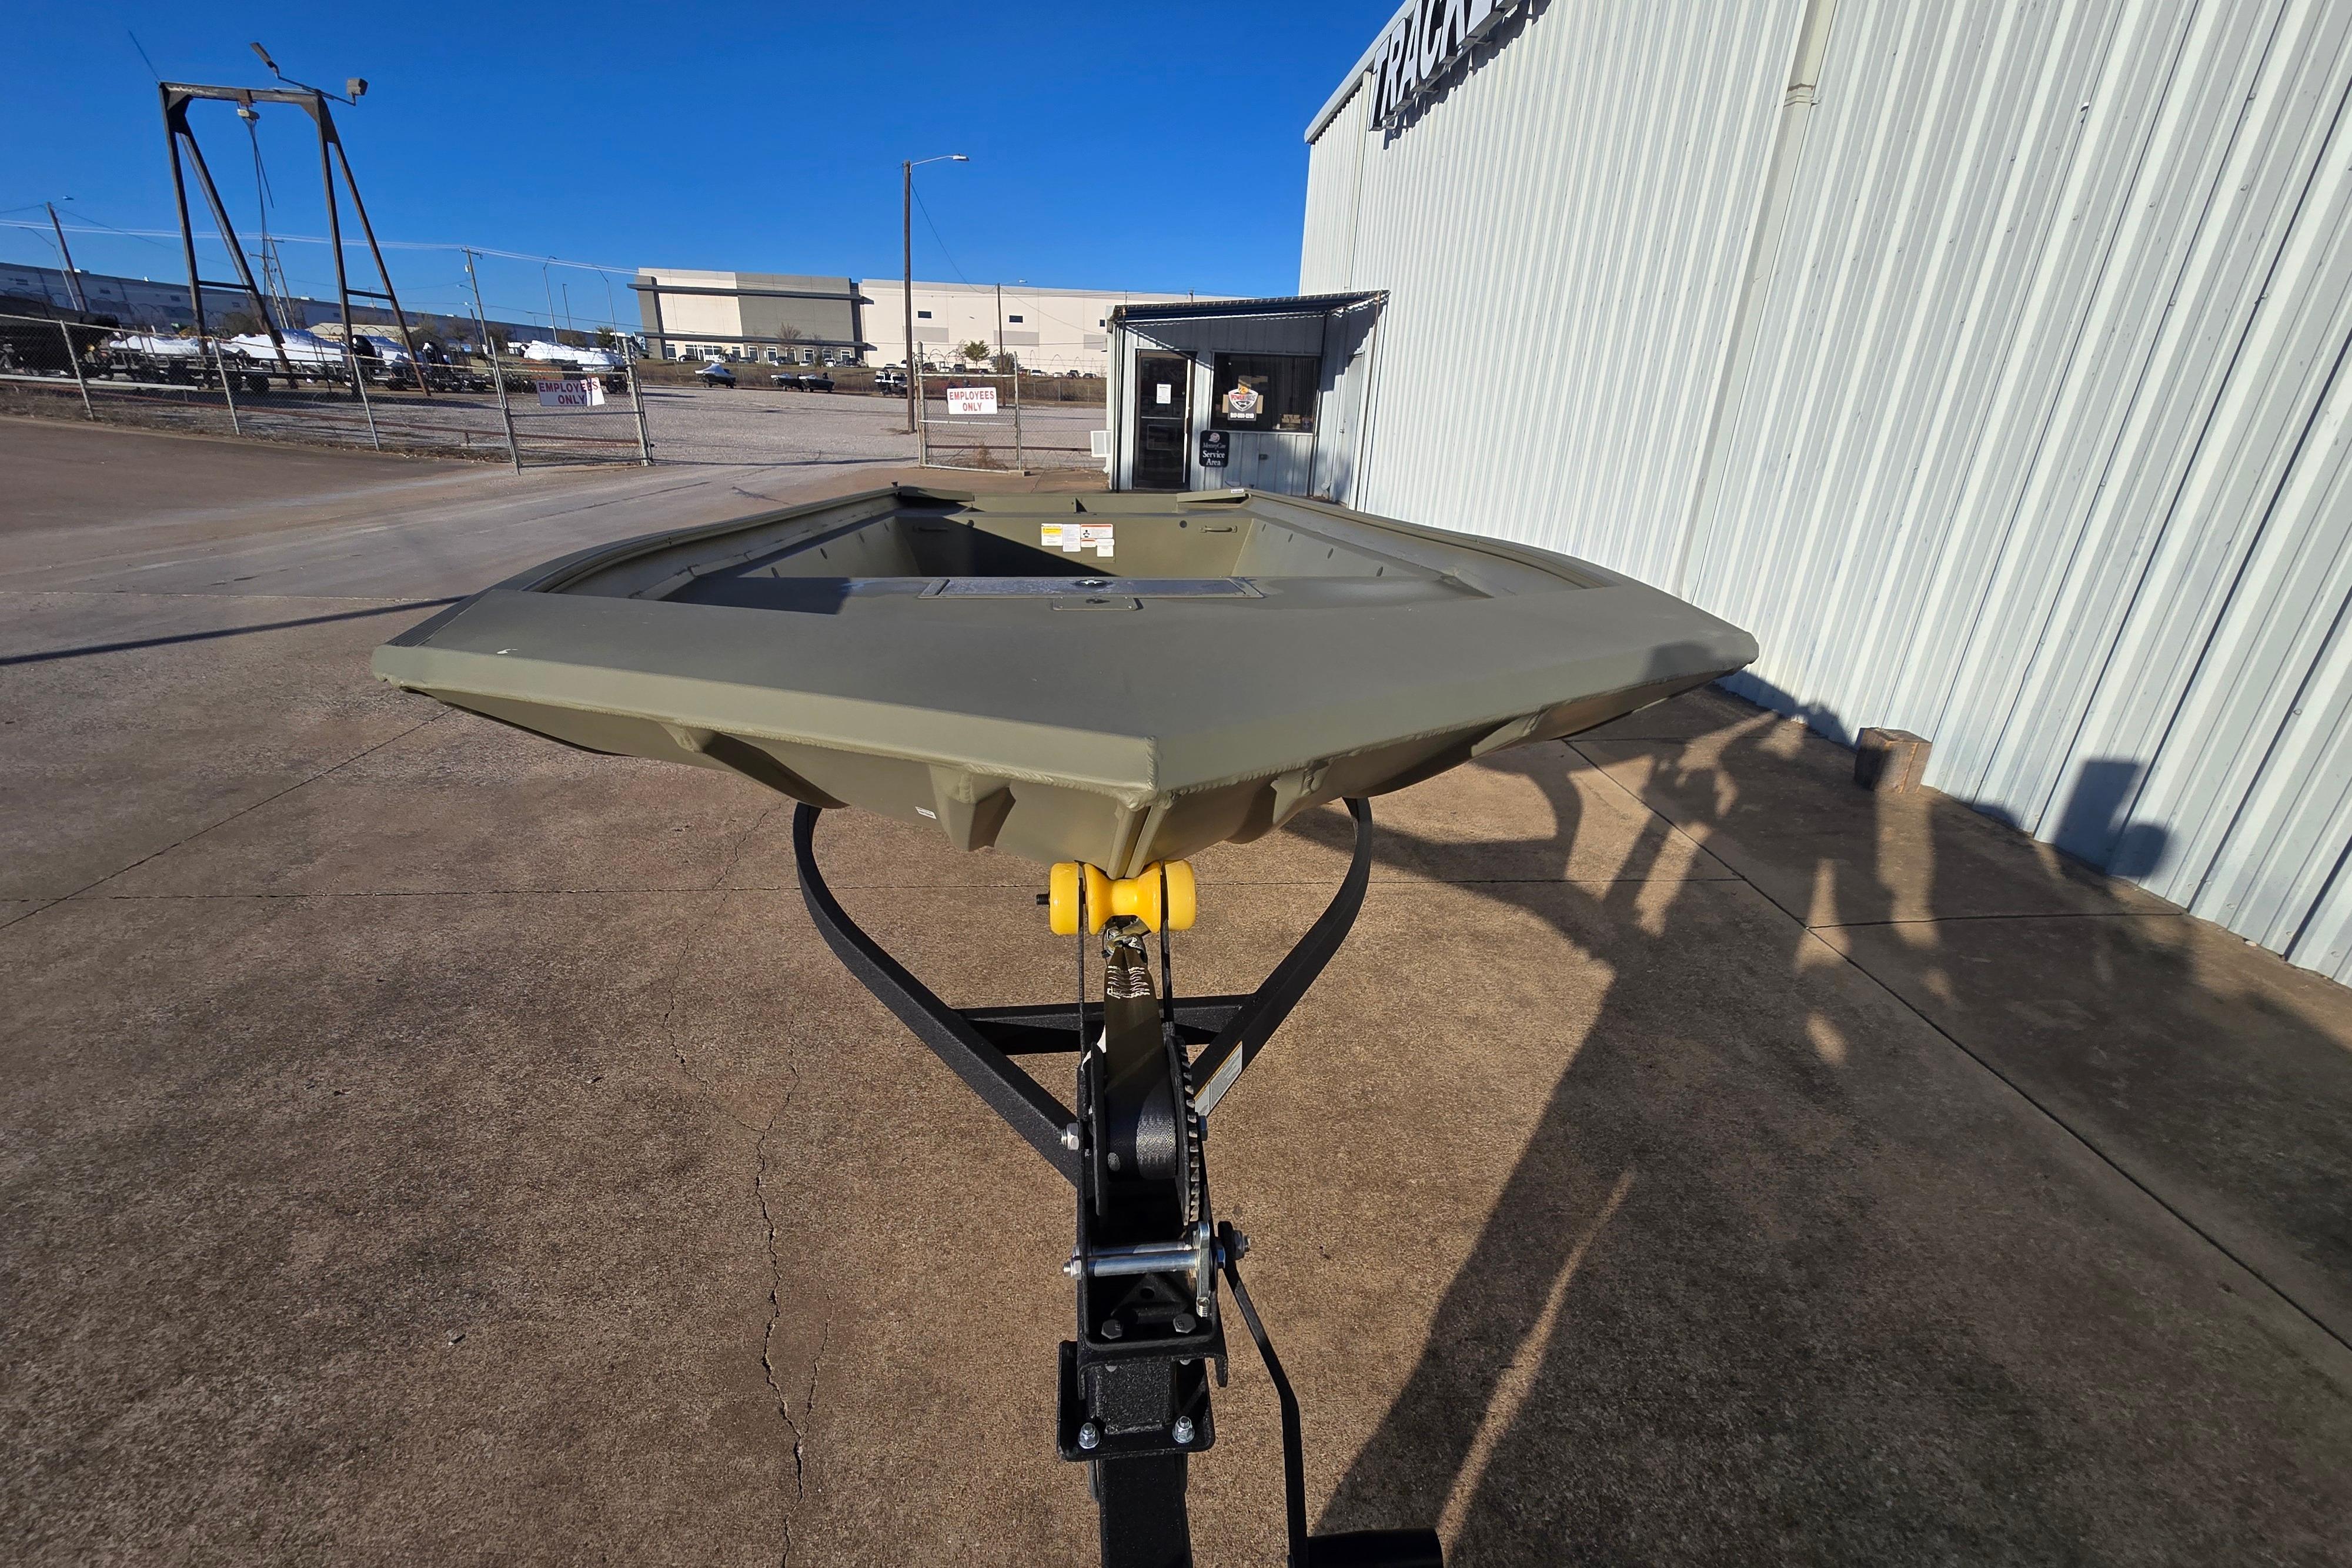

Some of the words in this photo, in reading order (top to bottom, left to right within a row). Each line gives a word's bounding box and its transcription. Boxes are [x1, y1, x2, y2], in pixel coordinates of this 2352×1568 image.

[1369, 0, 1501, 131] TRACK
[558, 394, 585, 404] ONLY
[950, 391, 994, 400] EMPLOYEES
[963, 403, 982, 411] ONLY
